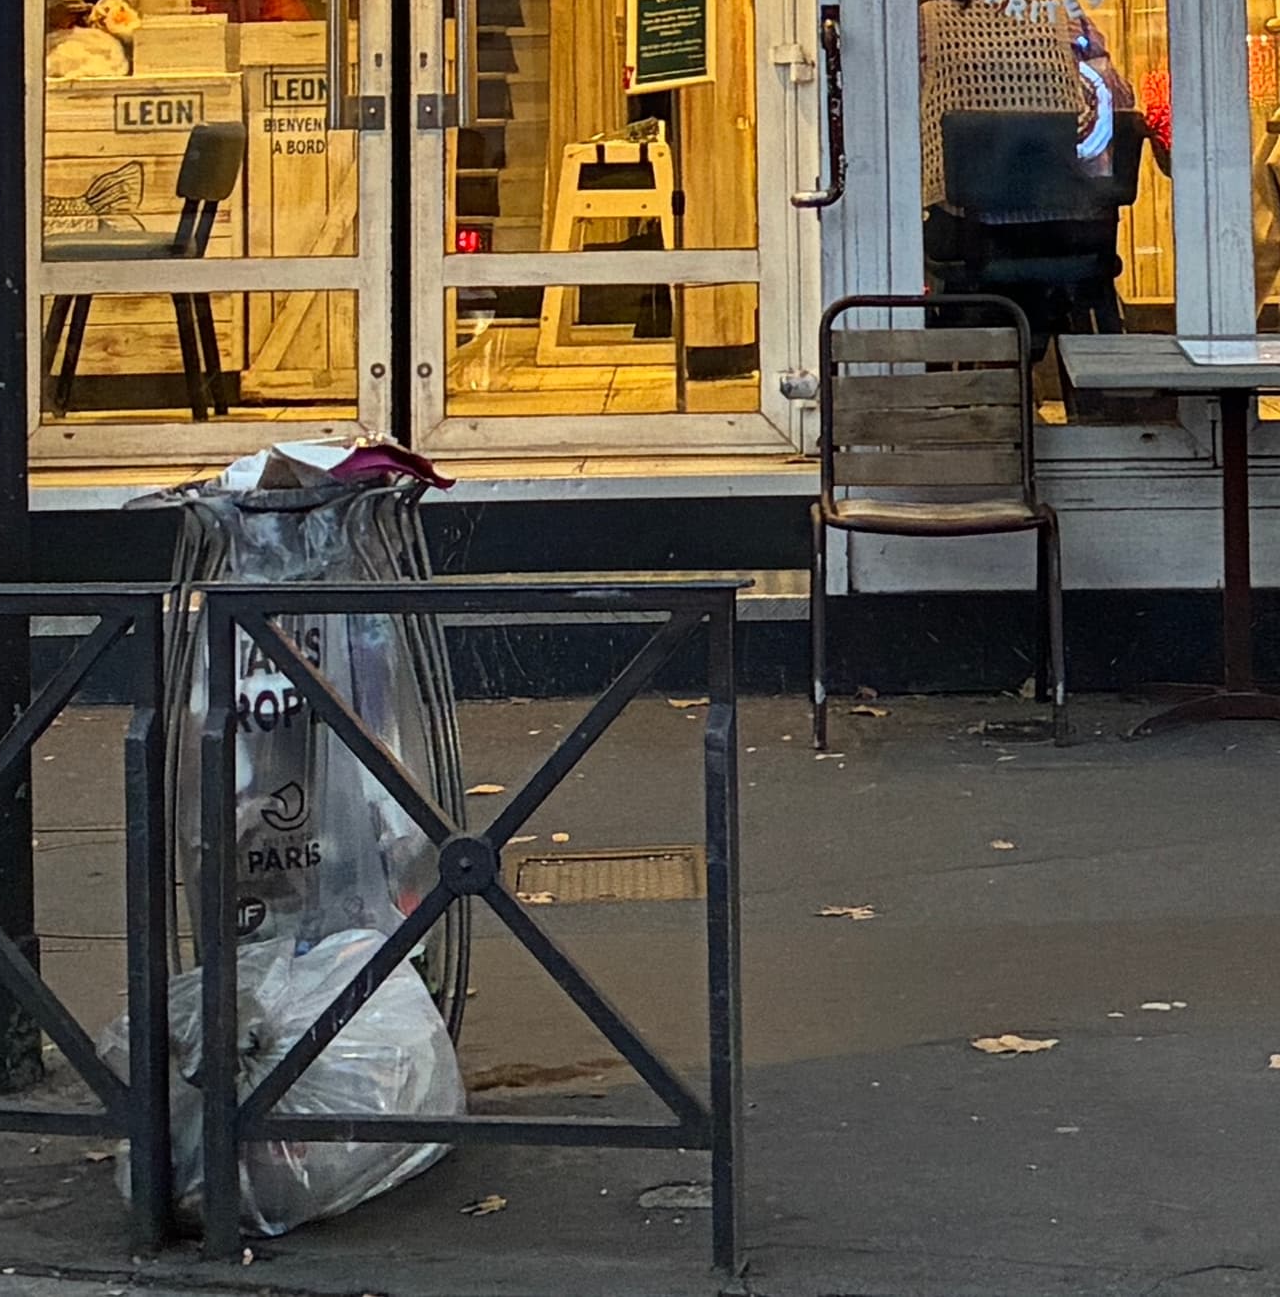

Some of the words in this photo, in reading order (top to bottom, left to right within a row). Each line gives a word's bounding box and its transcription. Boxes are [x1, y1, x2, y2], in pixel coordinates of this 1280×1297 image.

[263, 117, 328, 133] BIENVEN
[286, 139, 325, 154] BORD
[248, 843, 321, 874] PARIS
